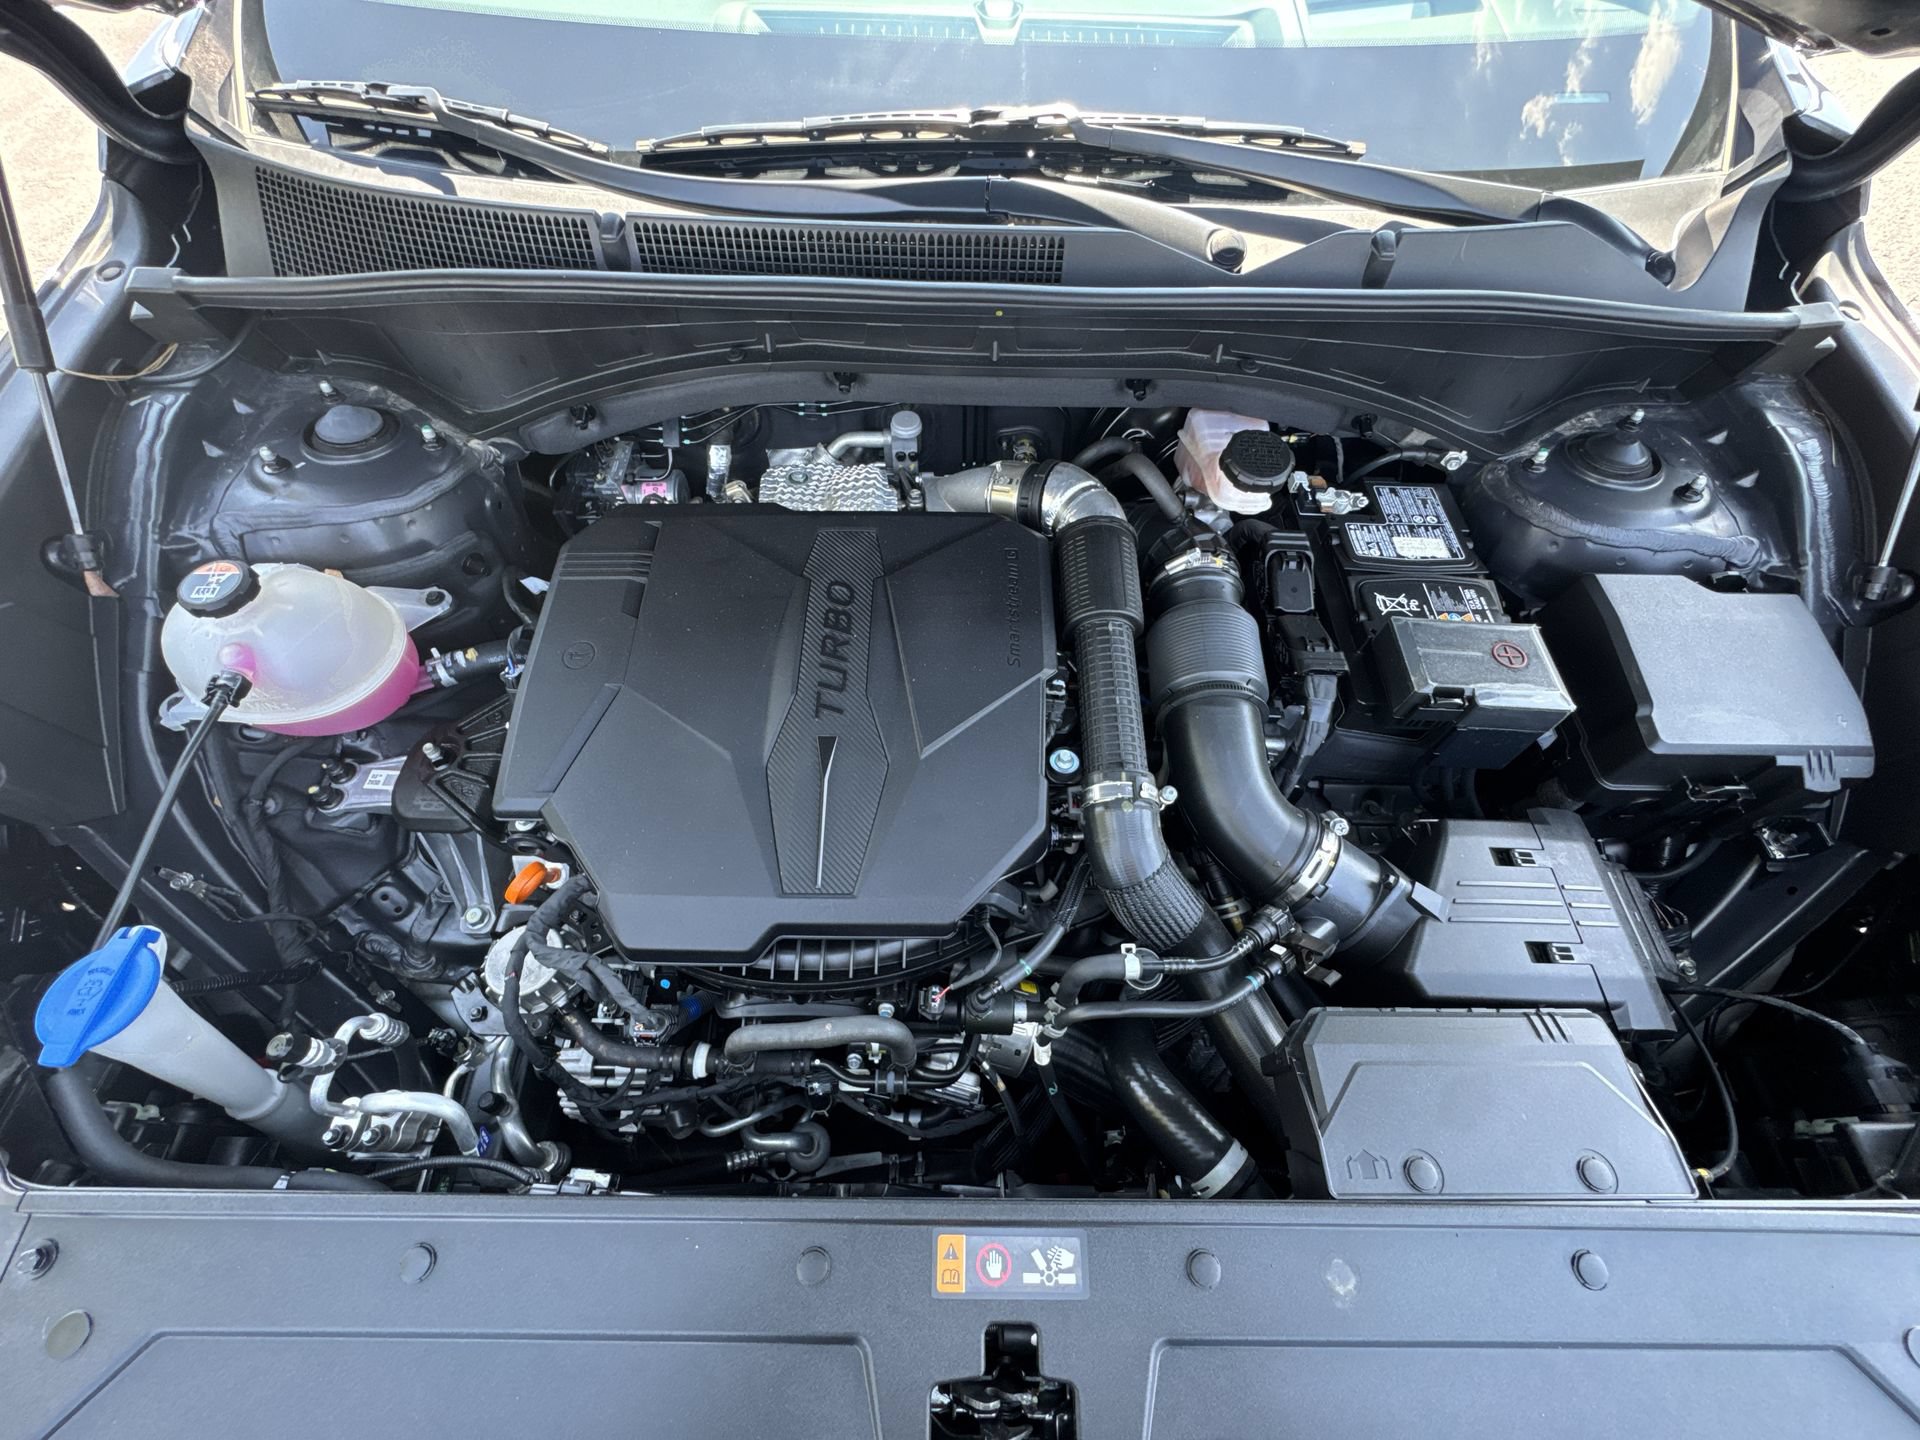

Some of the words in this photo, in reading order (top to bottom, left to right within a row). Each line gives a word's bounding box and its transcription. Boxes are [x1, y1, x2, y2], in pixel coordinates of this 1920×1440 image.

[814, 580, 854, 719] TURBO
[1006, 562, 1020, 668] Smartstream
[1409, 599, 1421, 611] Pb
